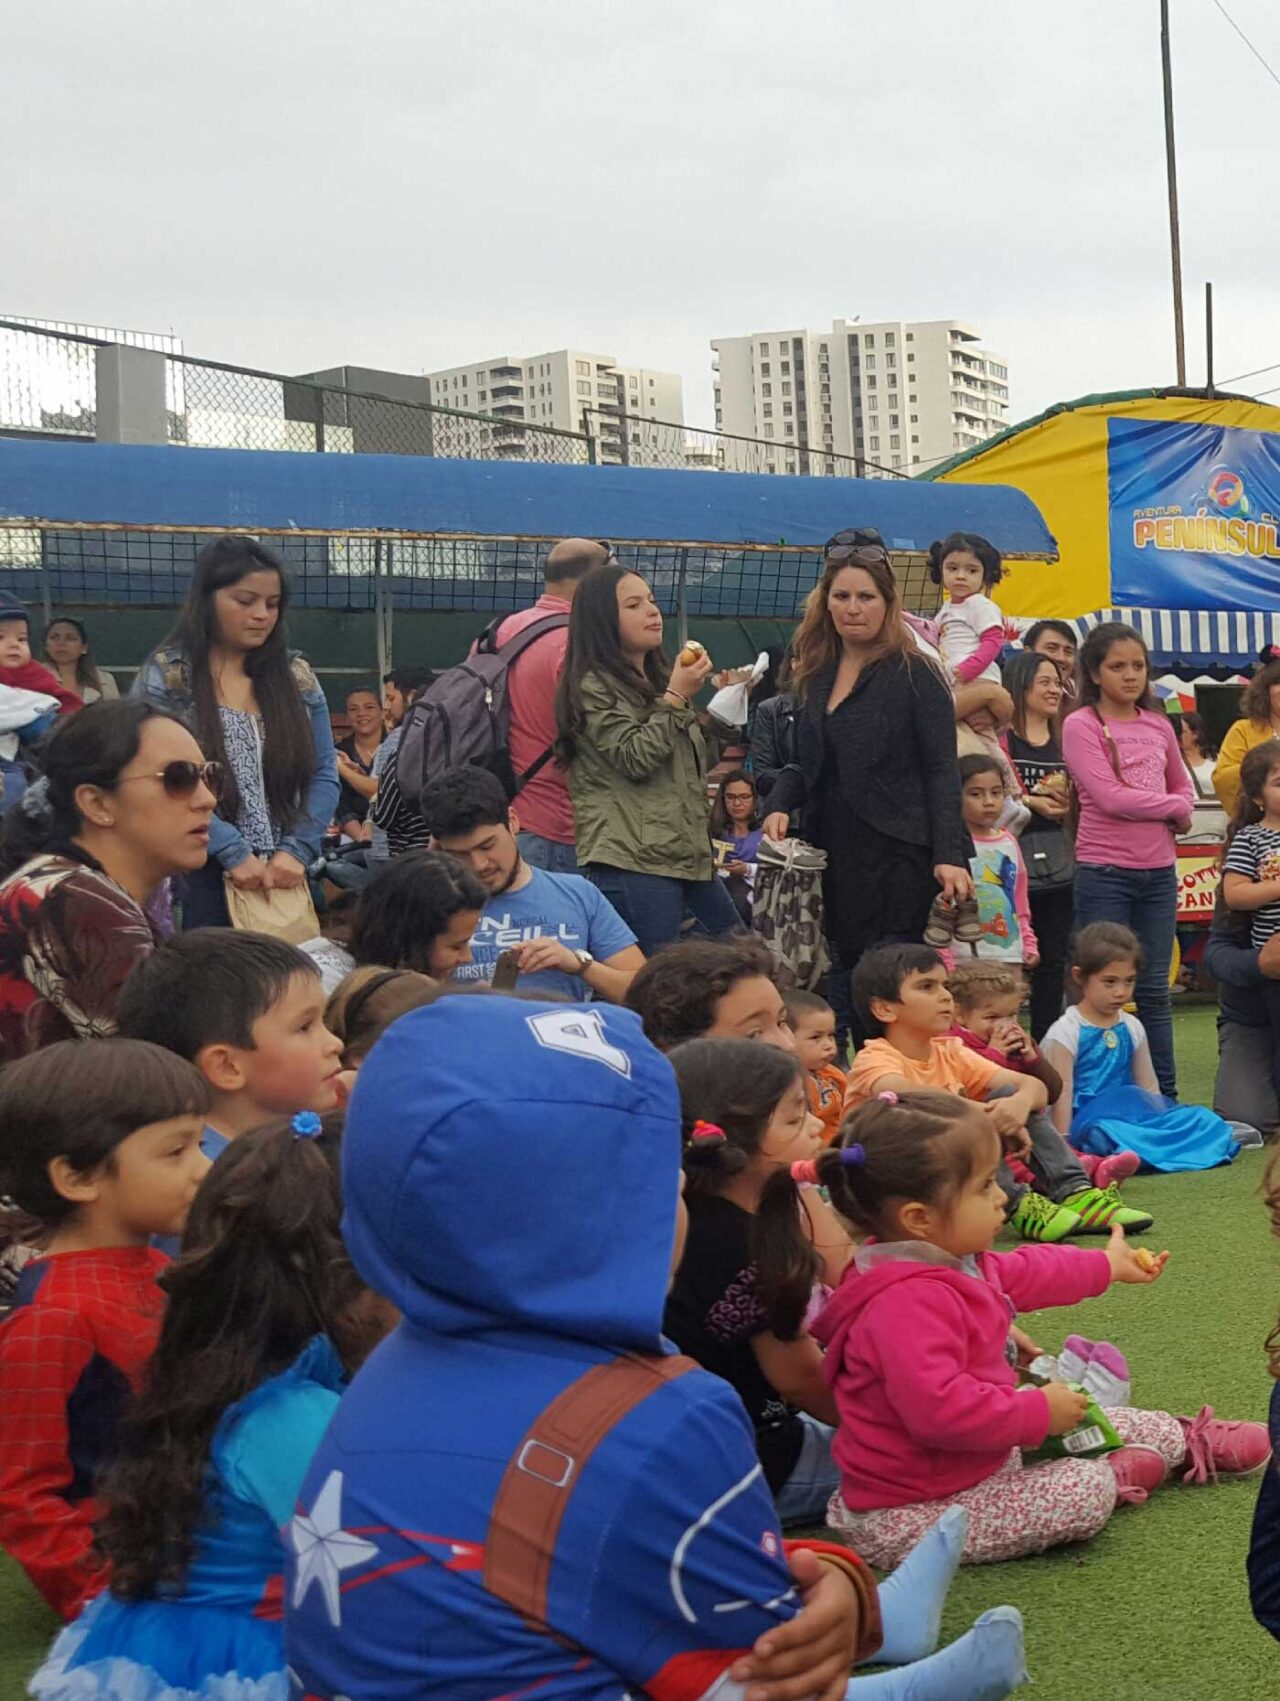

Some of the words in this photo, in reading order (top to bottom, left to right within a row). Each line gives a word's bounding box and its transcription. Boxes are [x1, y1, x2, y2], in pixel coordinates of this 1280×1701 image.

[1133, 505, 1183, 519] AVENTURA
[1176, 864, 1217, 892] OTT
[1176, 892, 1213, 909] AN
[524, 1009, 631, 1080] A
